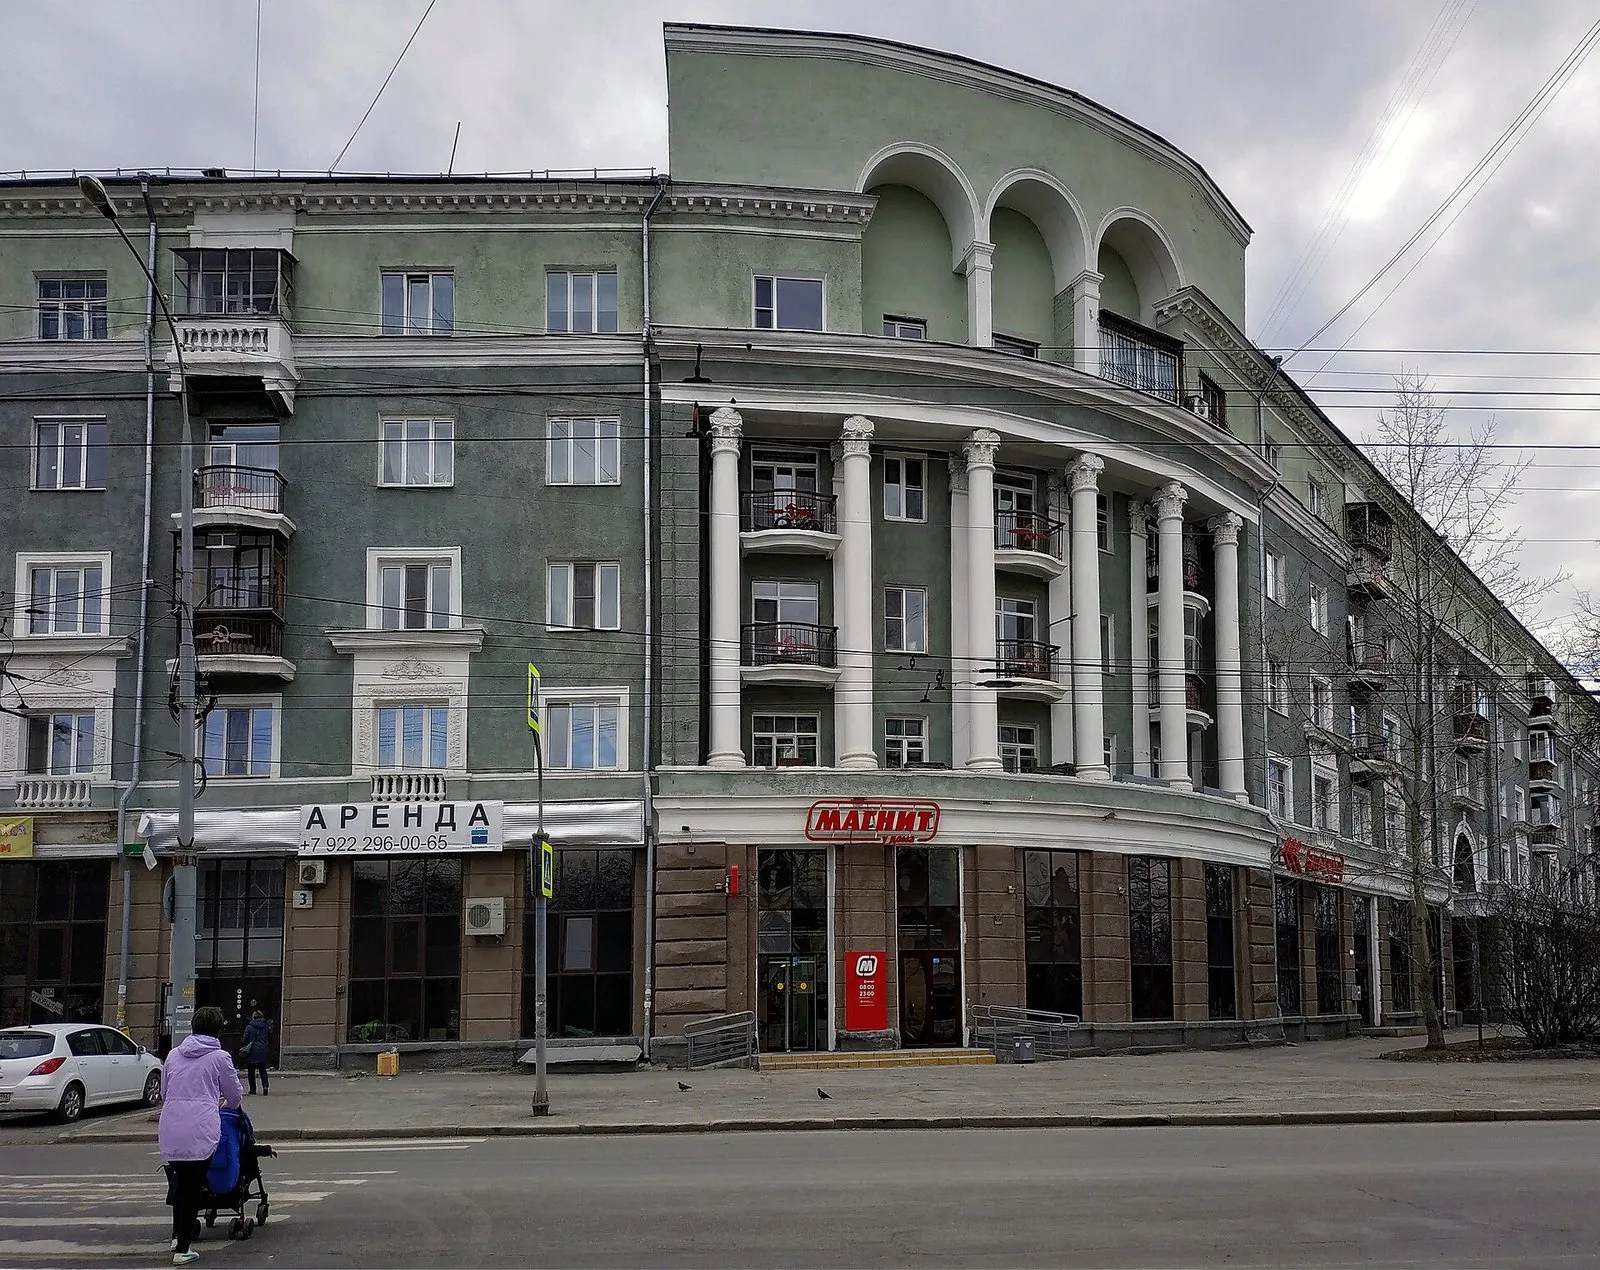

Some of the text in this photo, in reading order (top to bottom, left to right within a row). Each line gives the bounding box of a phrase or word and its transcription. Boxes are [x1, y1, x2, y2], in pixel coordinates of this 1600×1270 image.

[305, 803, 490, 832] АРЕНДА
[815, 810, 932, 832] МАГНИТ
[300, 834, 448, 852] +7 922 296-00-65
[299, 892, 308, 906] 3
